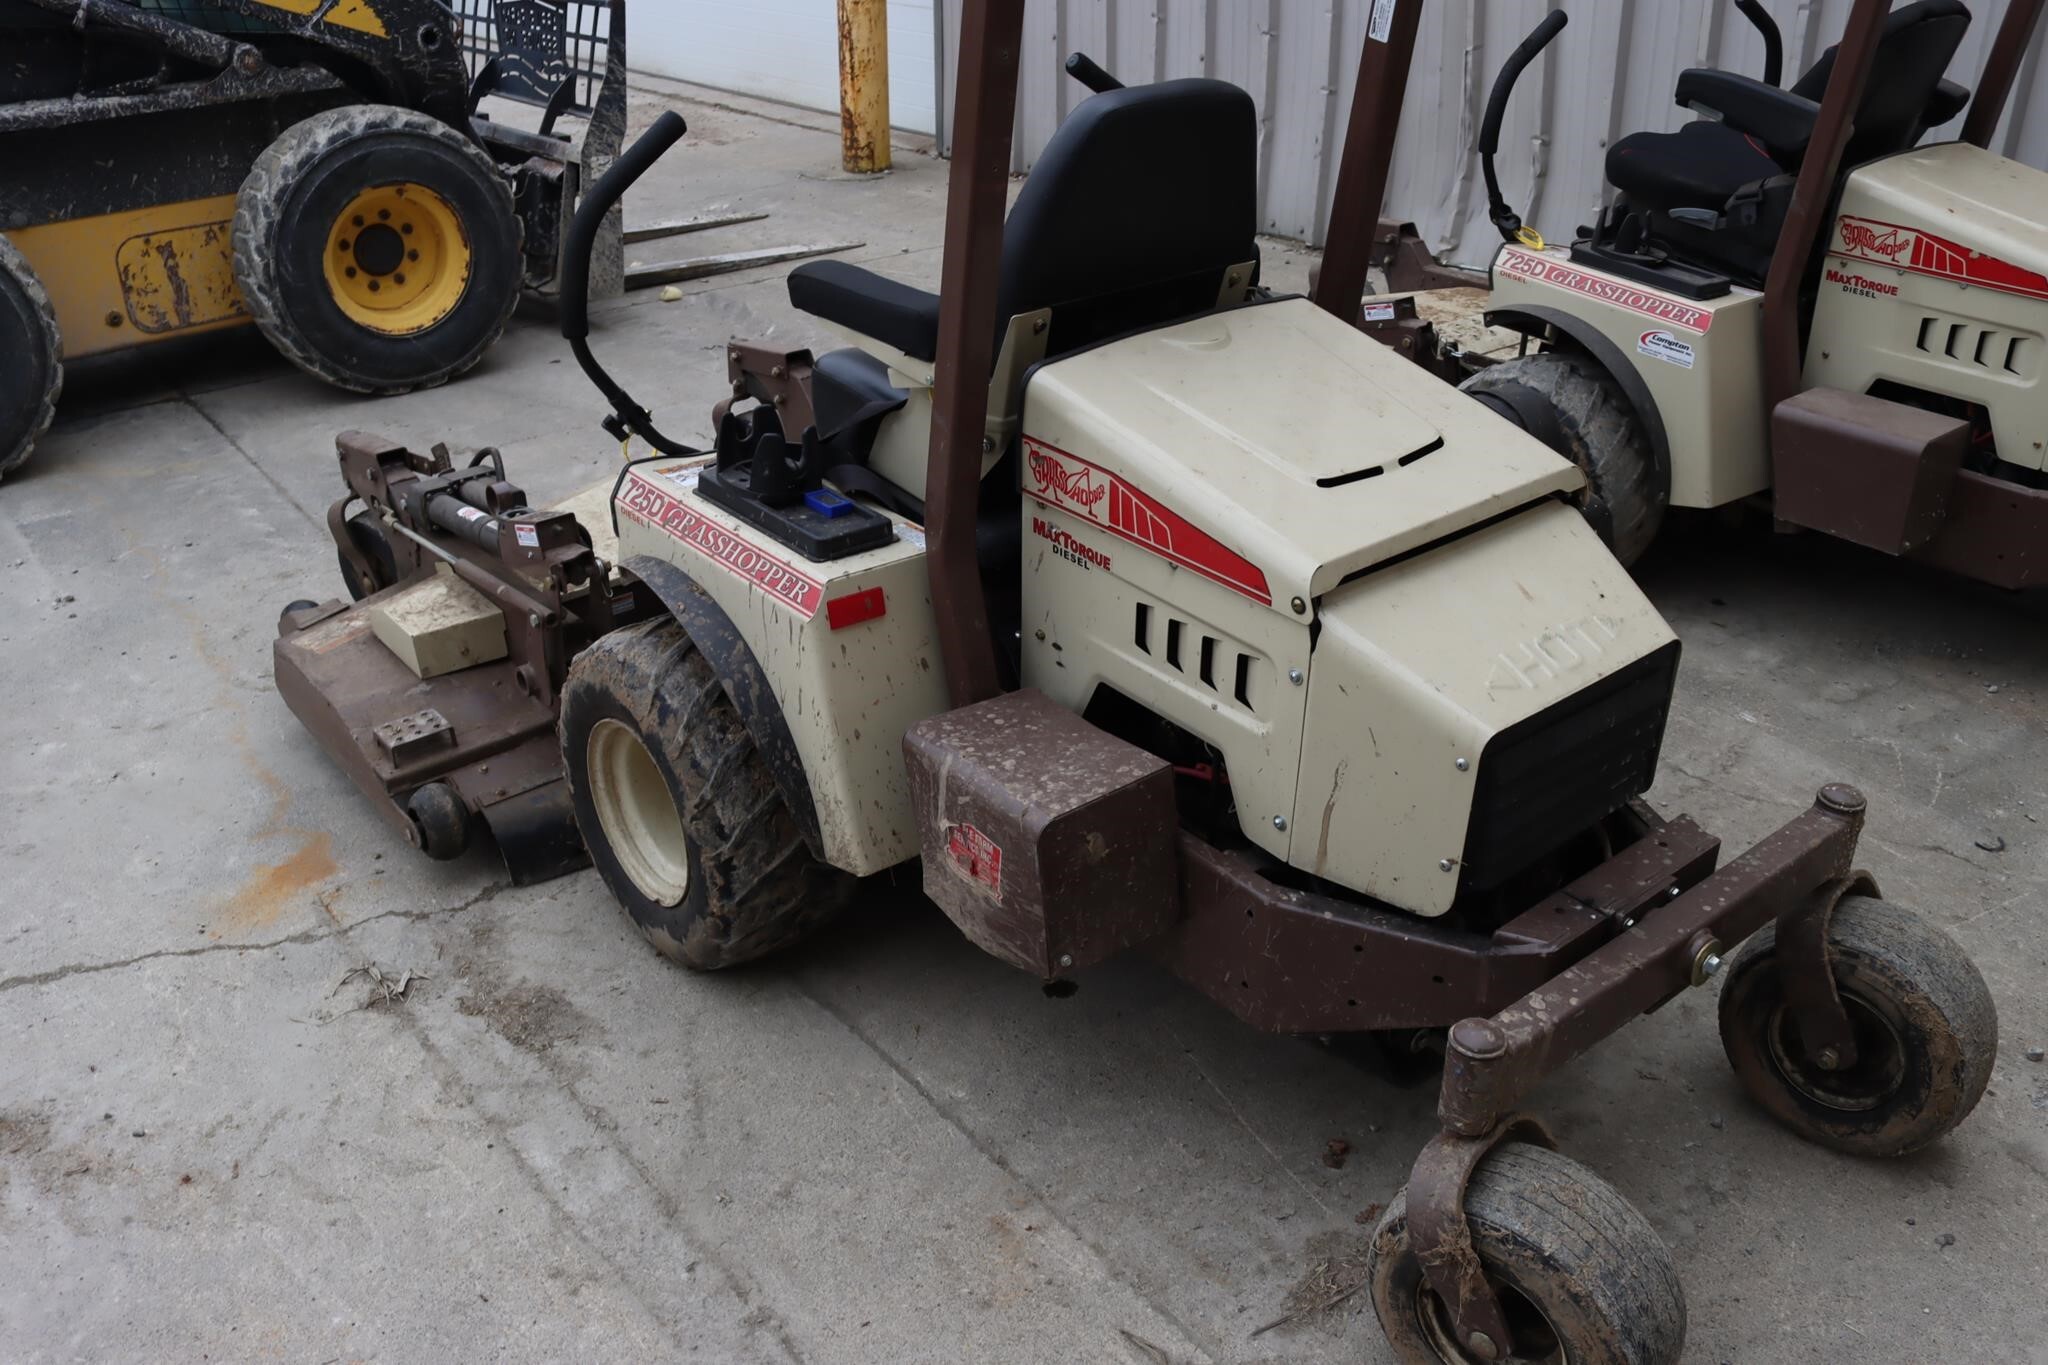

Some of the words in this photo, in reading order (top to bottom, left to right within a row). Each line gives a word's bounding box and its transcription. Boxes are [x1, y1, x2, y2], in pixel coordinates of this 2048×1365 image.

[1500, 270, 1527, 284] DIESEL
[1502, 251, 1547, 276] 725D
[1551, 269, 1701, 326] GRASSHOPPER
[1842, 285, 1877, 299] DIESEL
[1651, 334, 1690, 351] Compton
[620, 505, 646, 528] DIESEL
[622, 477, 665, 518] 725D
[666, 506, 811, 604] GRASSHOPPER
[1052, 544, 1090, 570] DIESEL
